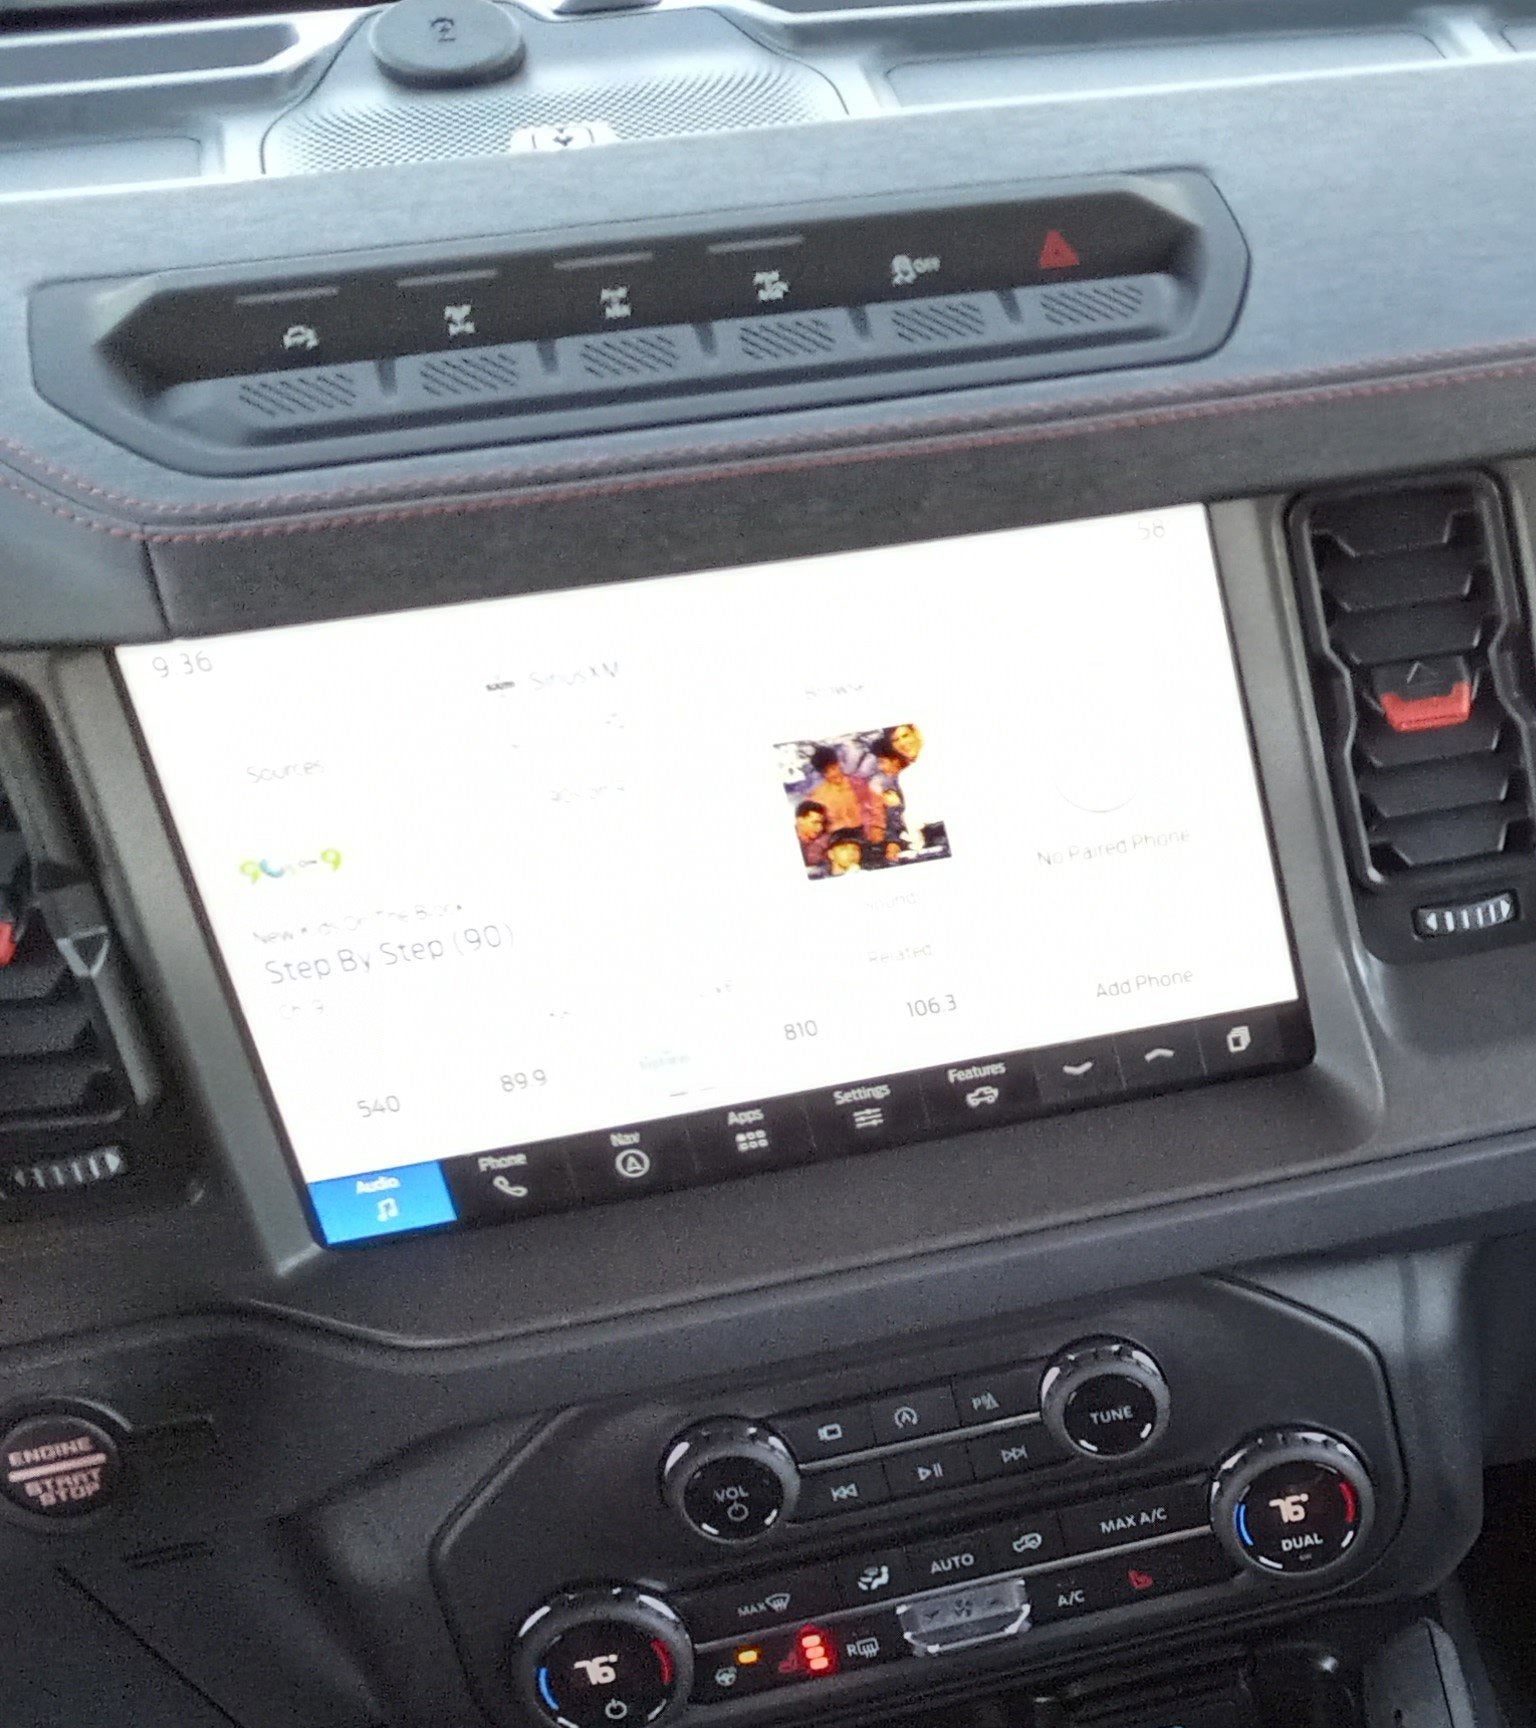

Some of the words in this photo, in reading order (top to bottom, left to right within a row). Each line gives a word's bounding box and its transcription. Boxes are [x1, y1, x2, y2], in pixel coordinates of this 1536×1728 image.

[264, 957, 333, 986] Step
[336, 947, 372, 974] By
[378, 938, 445, 966] Step
[1096, 979, 1132, 998] Add
[1135, 969, 1194, 990] Phone
[784, 1019, 818, 1041] 810
[947, 1061, 1007, 1084] Features
[833, 1083, 891, 1106] Settings
[356, 1094, 401, 1119] 540
[727, 1108, 765, 1126] Apps
[609, 1131, 641, 1148] Nav
[477, 1153, 528, 1172] Phone
[356, 1176, 401, 1194] Audio
[1089, 1404, 1133, 1426] TUNE
[715, 1484, 750, 1503] VOL
[1100, 1514, 1137, 1534] MAX
[1139, 1507, 1168, 1526] A/C
[1281, 1532, 1324, 1552] DUAL
[930, 1552, 975, 1575] AUTO
[1057, 1588, 1086, 1608] A/C
[737, 1602, 767, 1617] MAX
